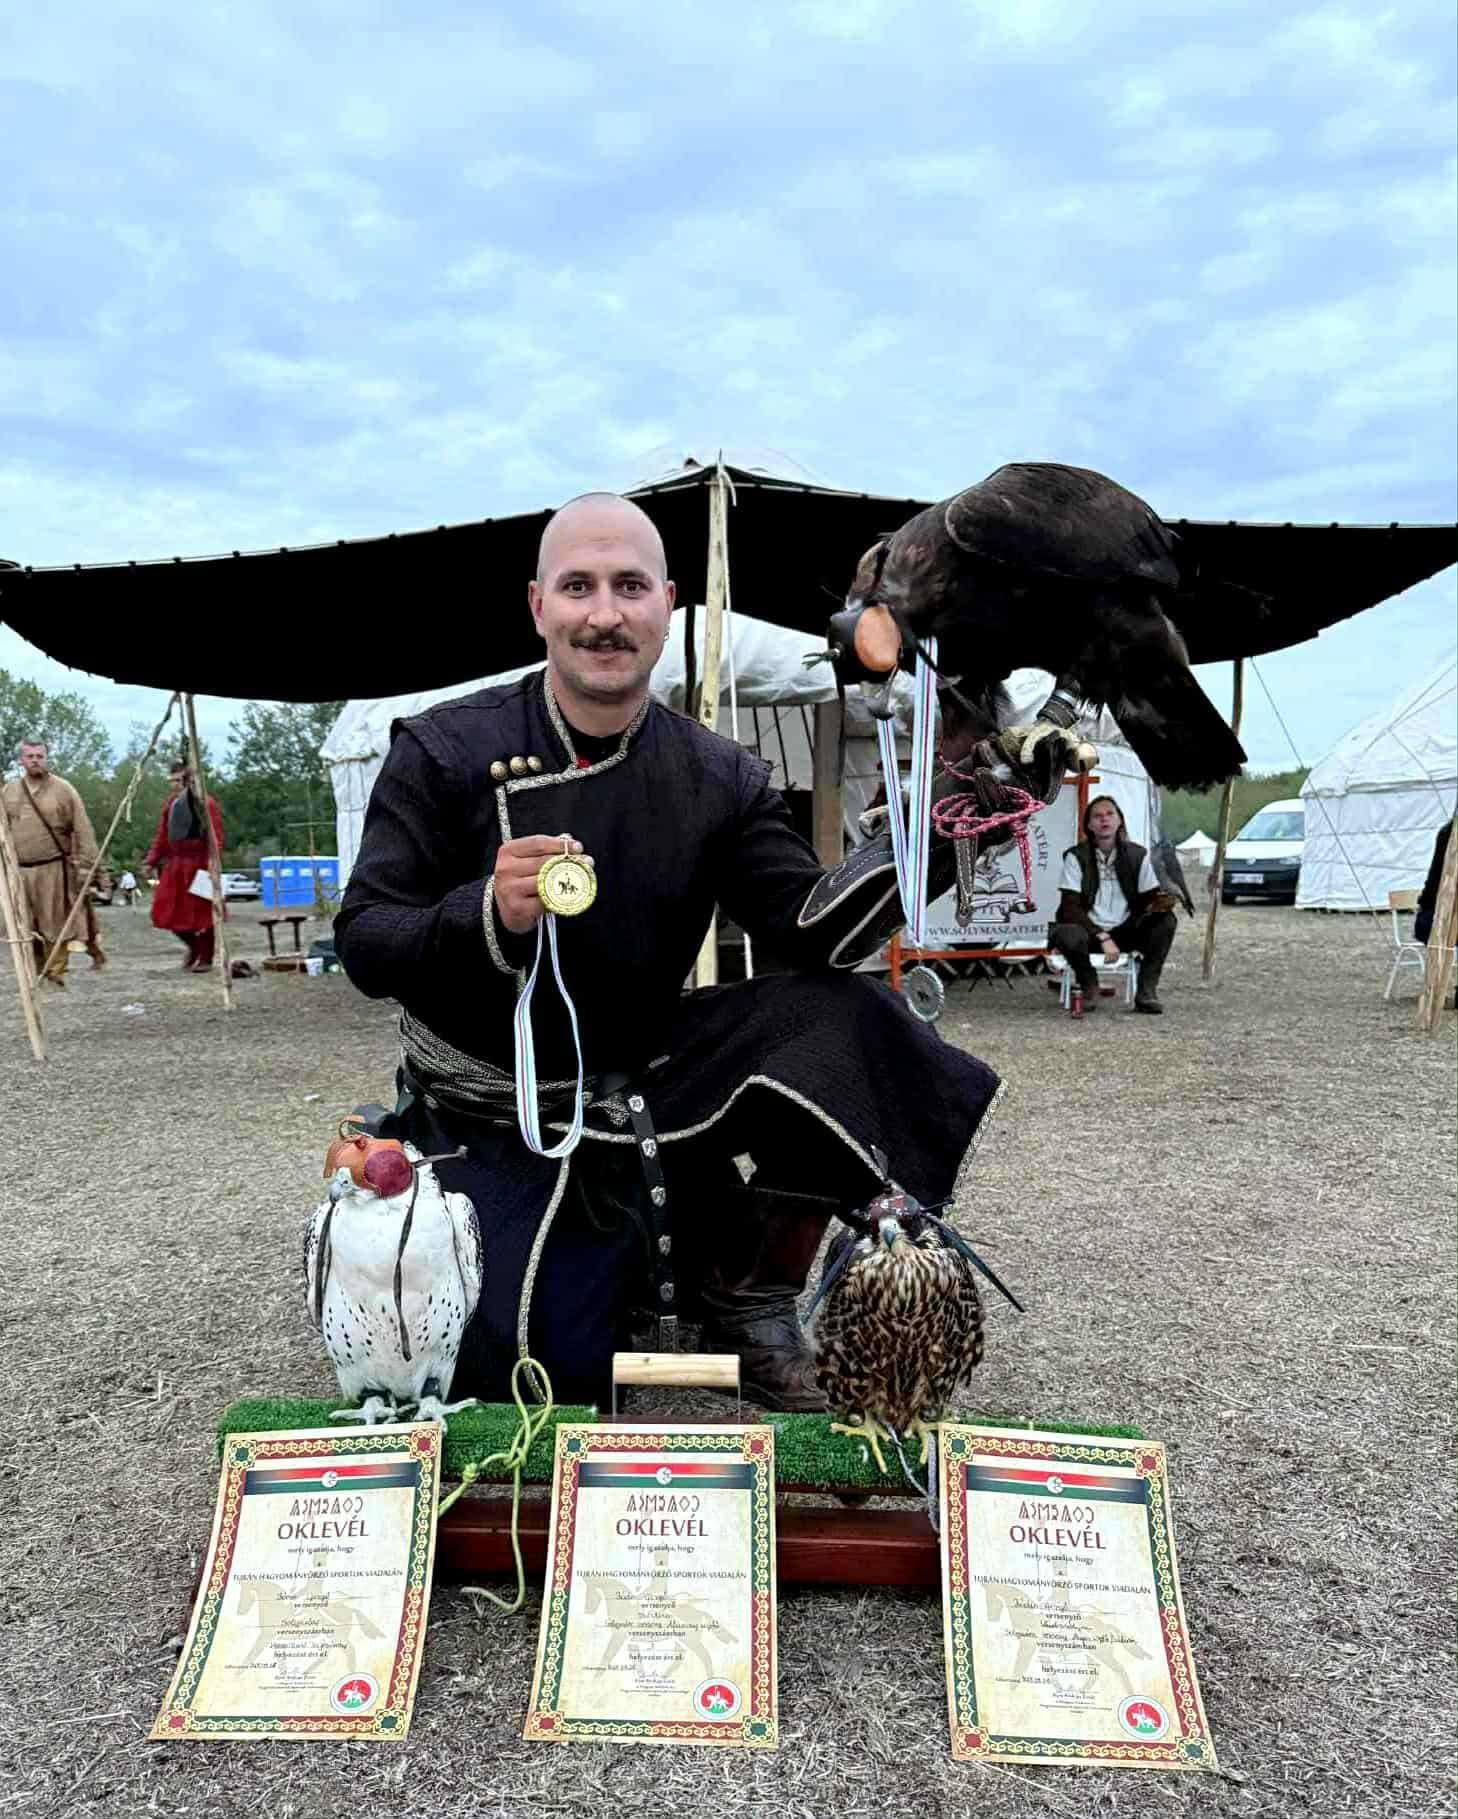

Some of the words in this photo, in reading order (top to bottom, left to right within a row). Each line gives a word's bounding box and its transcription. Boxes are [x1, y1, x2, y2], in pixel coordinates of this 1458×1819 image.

[277, 1515, 369, 1540] OKLEVÉL
[616, 1513, 709, 1537] OKLEVÉL
[1009, 1525, 1107, 1550] OKLEVÉL
